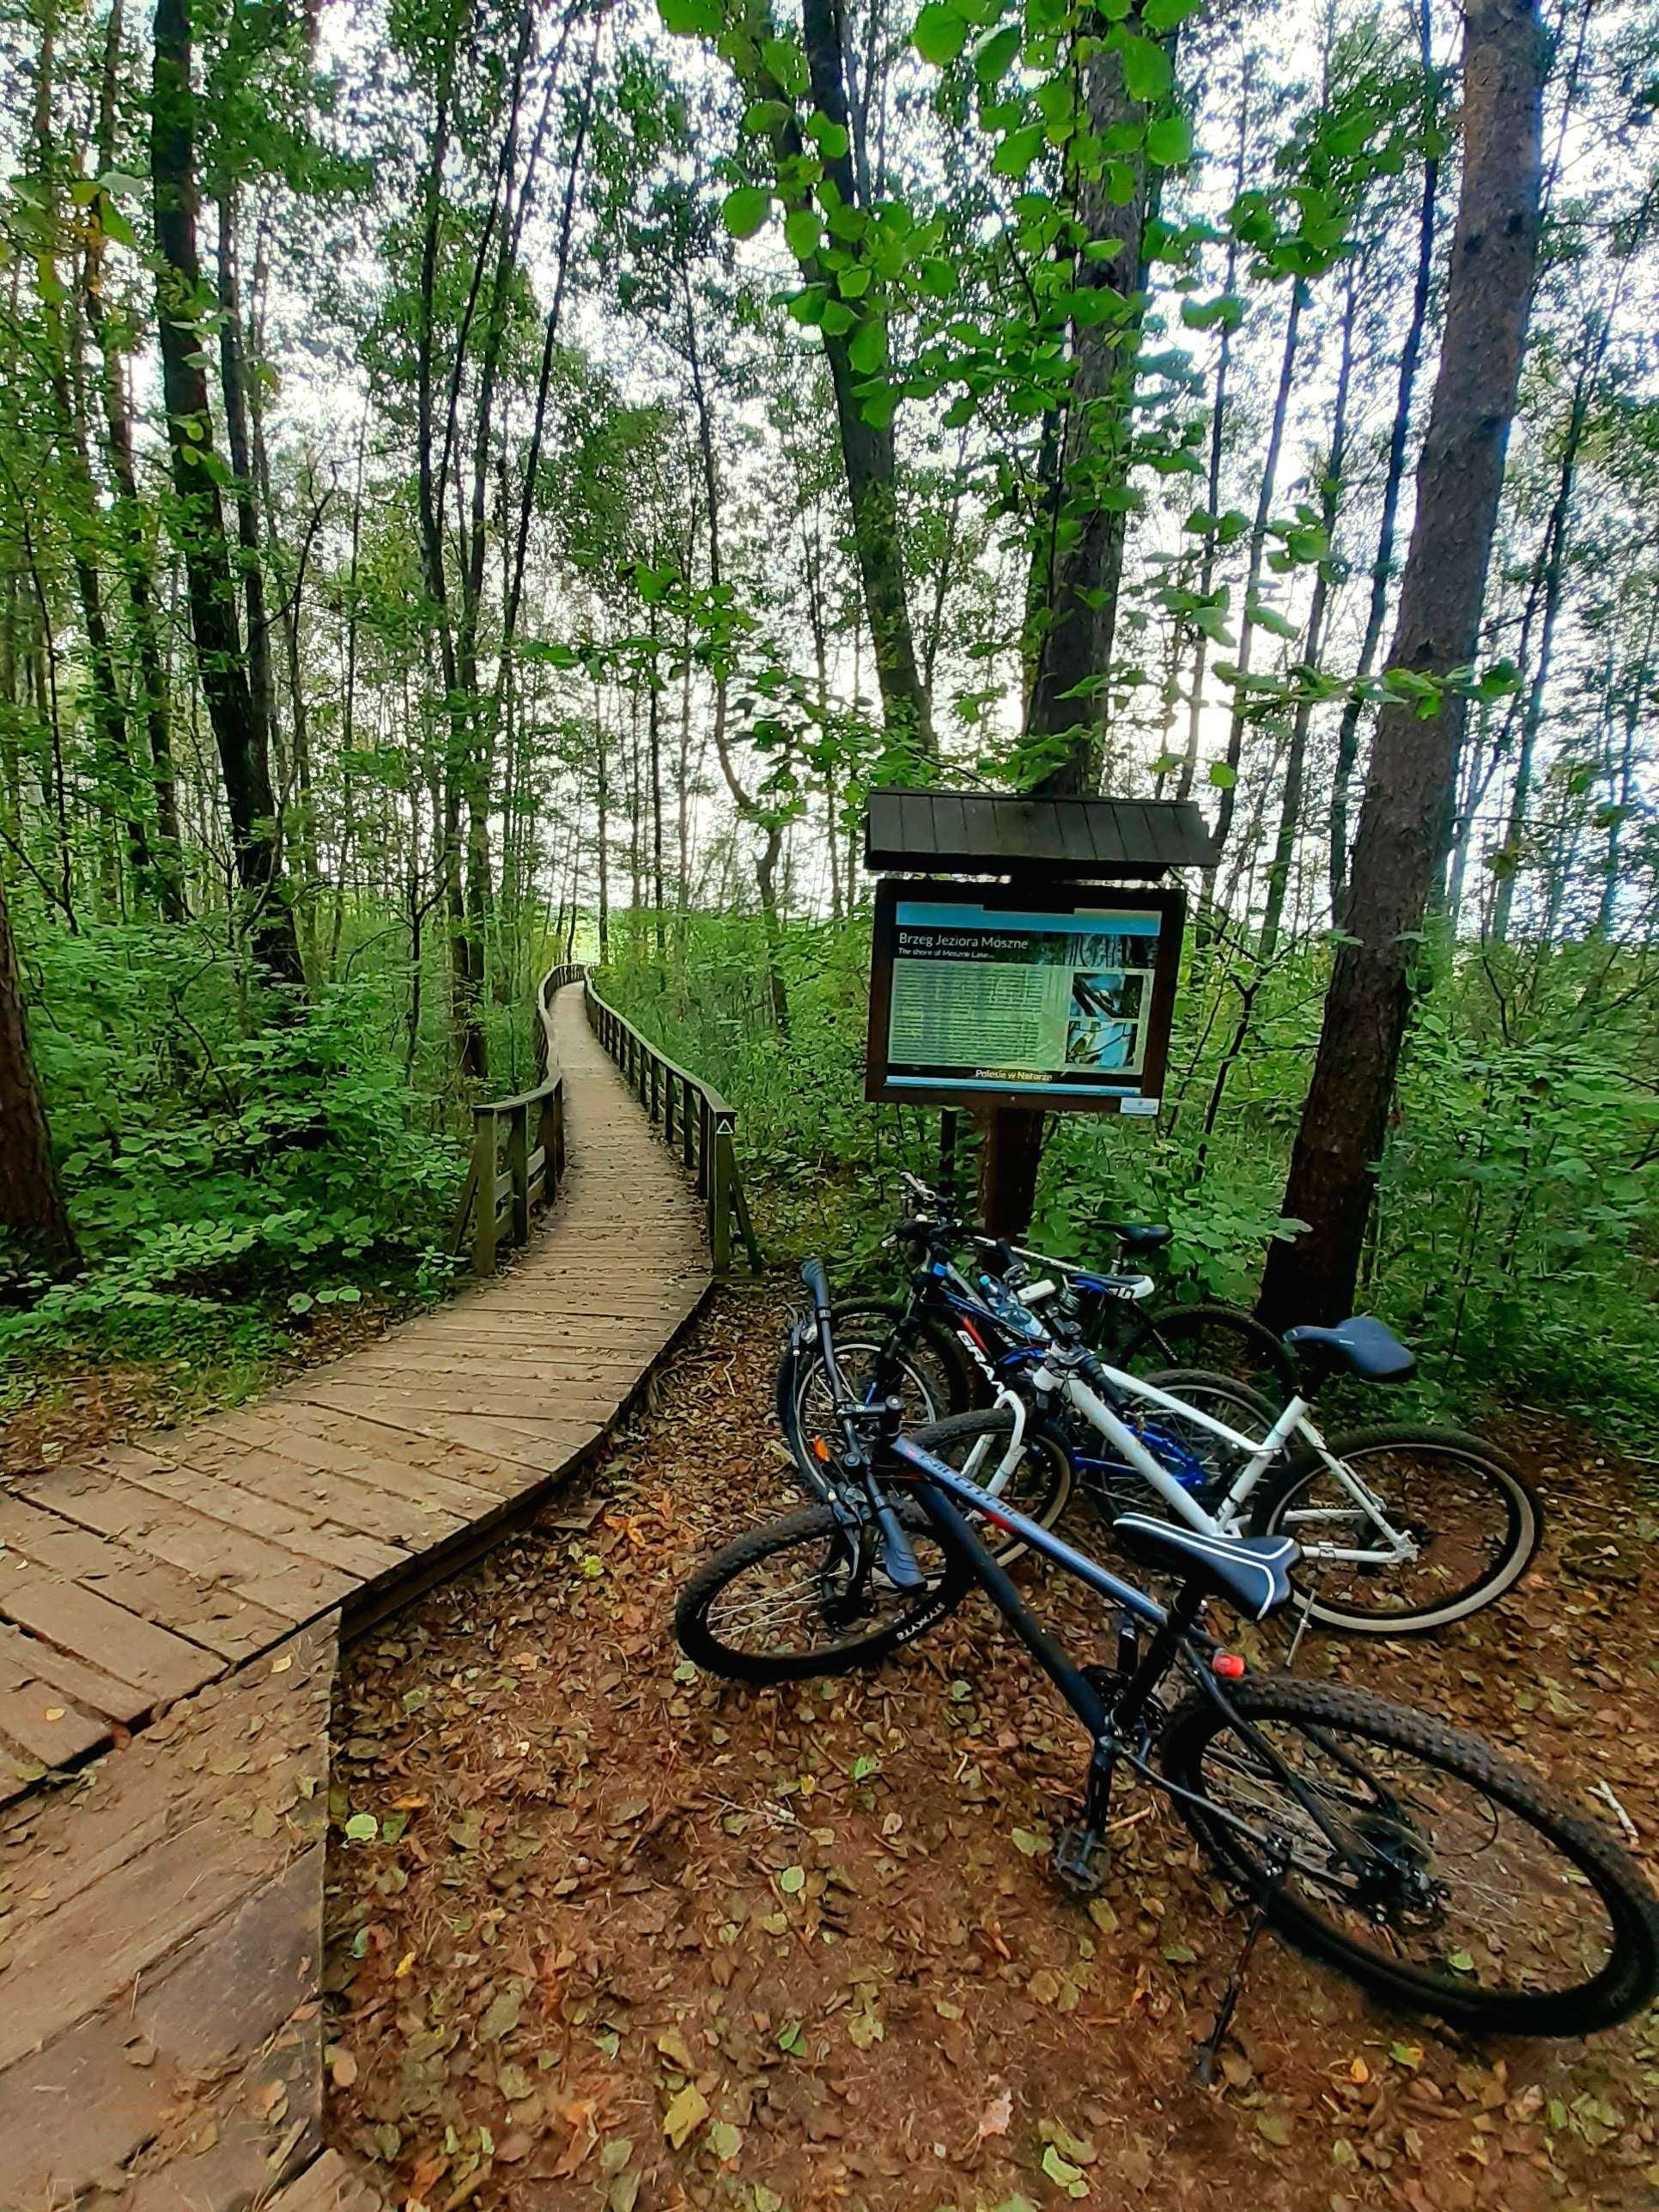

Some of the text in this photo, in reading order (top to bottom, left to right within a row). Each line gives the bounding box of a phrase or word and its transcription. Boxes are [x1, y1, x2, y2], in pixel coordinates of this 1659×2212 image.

[899, 933, 1028, 950] Brzeg Jeziora Moszne
[898, 947, 911, 956] The
[975, 1069, 1006, 1079] Polesie
